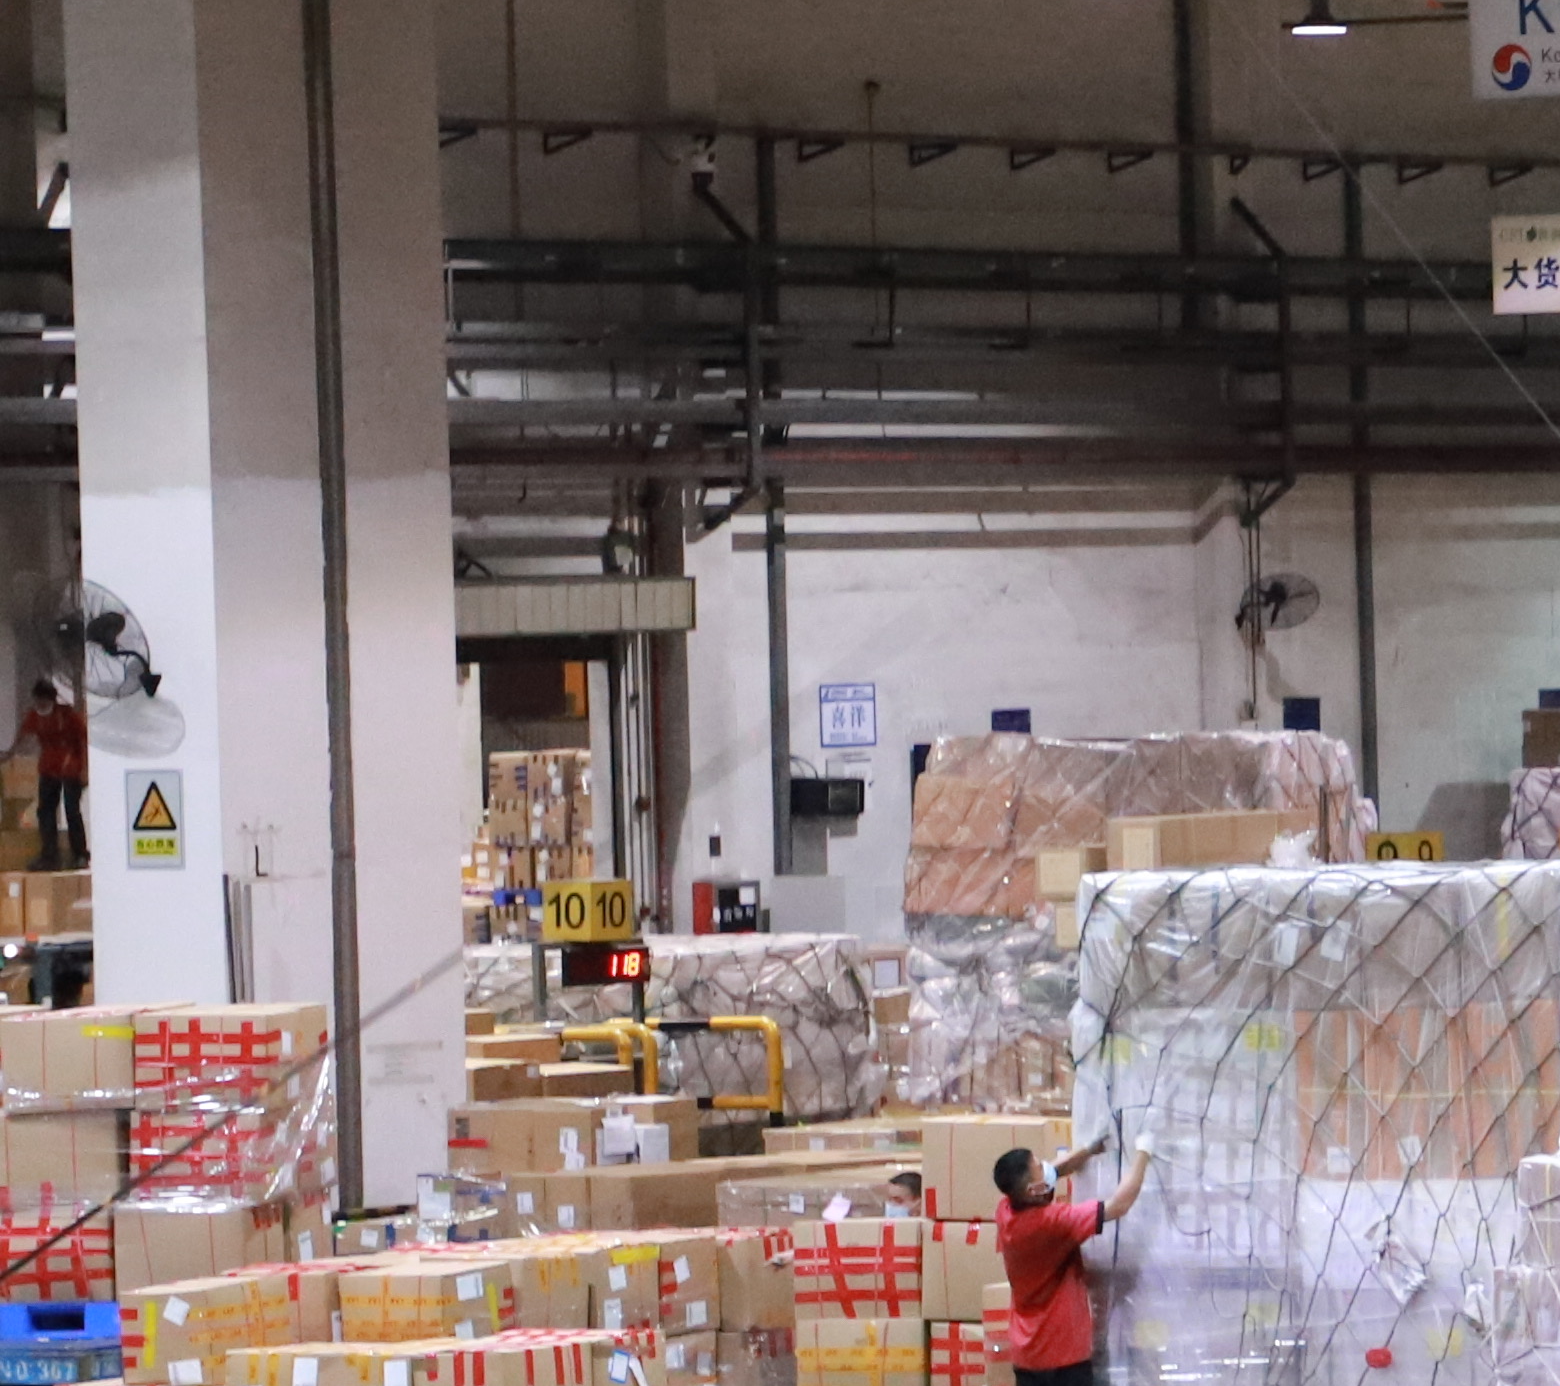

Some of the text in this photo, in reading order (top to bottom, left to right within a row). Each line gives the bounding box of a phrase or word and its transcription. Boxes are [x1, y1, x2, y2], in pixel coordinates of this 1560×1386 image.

[547, 891, 586, 930] 10
[596, 891, 626, 929] 10
[608, 951, 641, 978] 118
